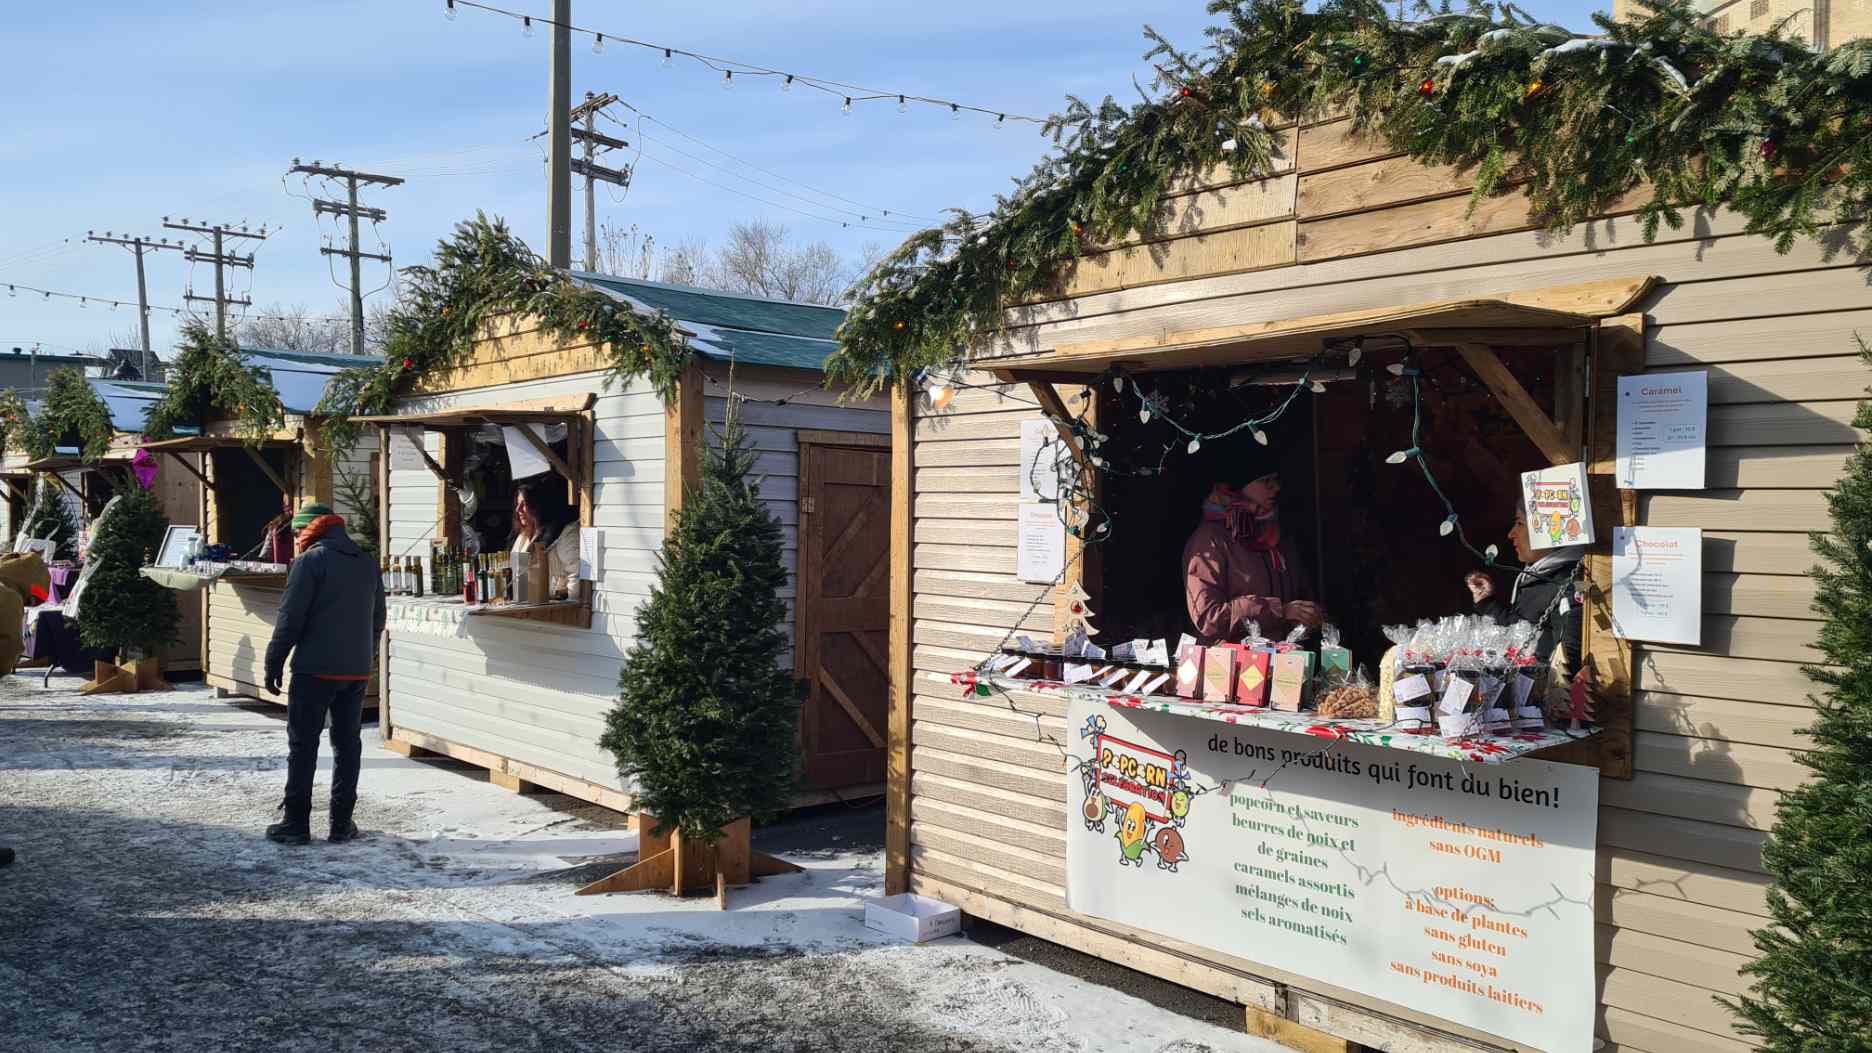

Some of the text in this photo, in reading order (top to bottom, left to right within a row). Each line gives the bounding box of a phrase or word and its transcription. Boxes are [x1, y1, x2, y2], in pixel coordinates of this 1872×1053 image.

[1208, 733, 1560, 808] de bons produits qui font du bien!
[1230, 794, 1360, 828] popcorn et saveurs
[1391, 808, 1545, 849] ingrédients naturels
[1232, 812, 1355, 852] beurres de noix et
[1257, 841, 1329, 869] de graines
[1429, 840, 1502, 864] sans OGM
[1234, 860, 1356, 899] caramels assortis
[1235, 883, 1353, 923] mélanges de noix
[1416, 898, 1448, 919] base
[1450, 908, 1468, 924] de
[1471, 914, 1529, 939] plantes
[1241, 907, 1347, 945] sels aromatisés
[1424, 926, 1506, 957] sans gluten
[1431, 951, 1498, 978] sans soya
[1390, 960, 1544, 1014] sans produits laitiers
